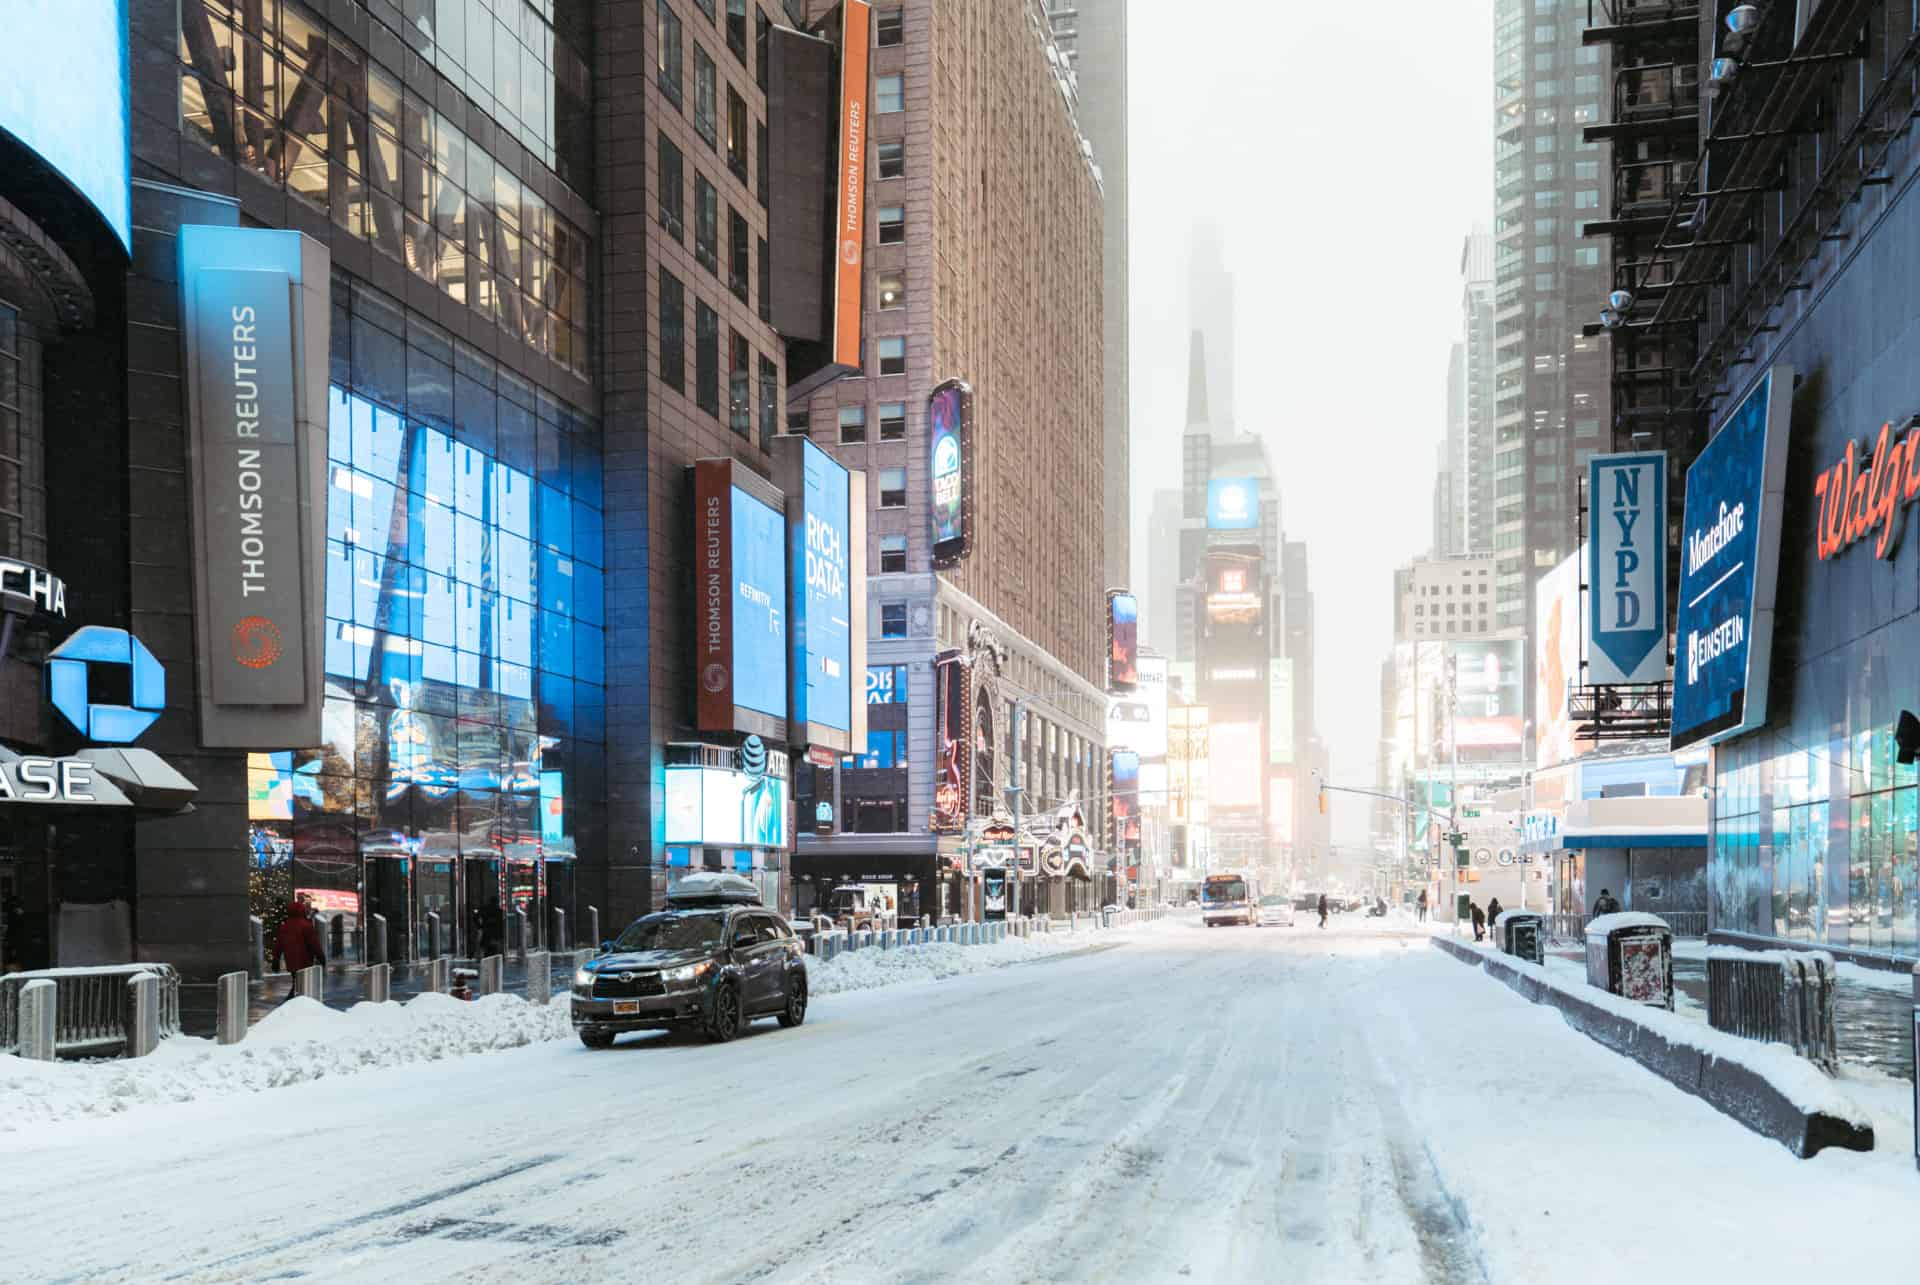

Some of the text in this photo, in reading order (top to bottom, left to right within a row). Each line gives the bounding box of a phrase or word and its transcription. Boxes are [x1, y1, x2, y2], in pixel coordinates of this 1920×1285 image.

[847, 100, 861, 232] THOMSON REUTERS
[232, 305, 265, 597] THOMSON REUTERS
[707, 496, 721, 654] THOMSON REUTERS
[1613, 468, 1641, 628] NYPD
[1688, 501, 1745, 577] Montefiore
[1698, 615, 1744, 667] EINSTEIN
